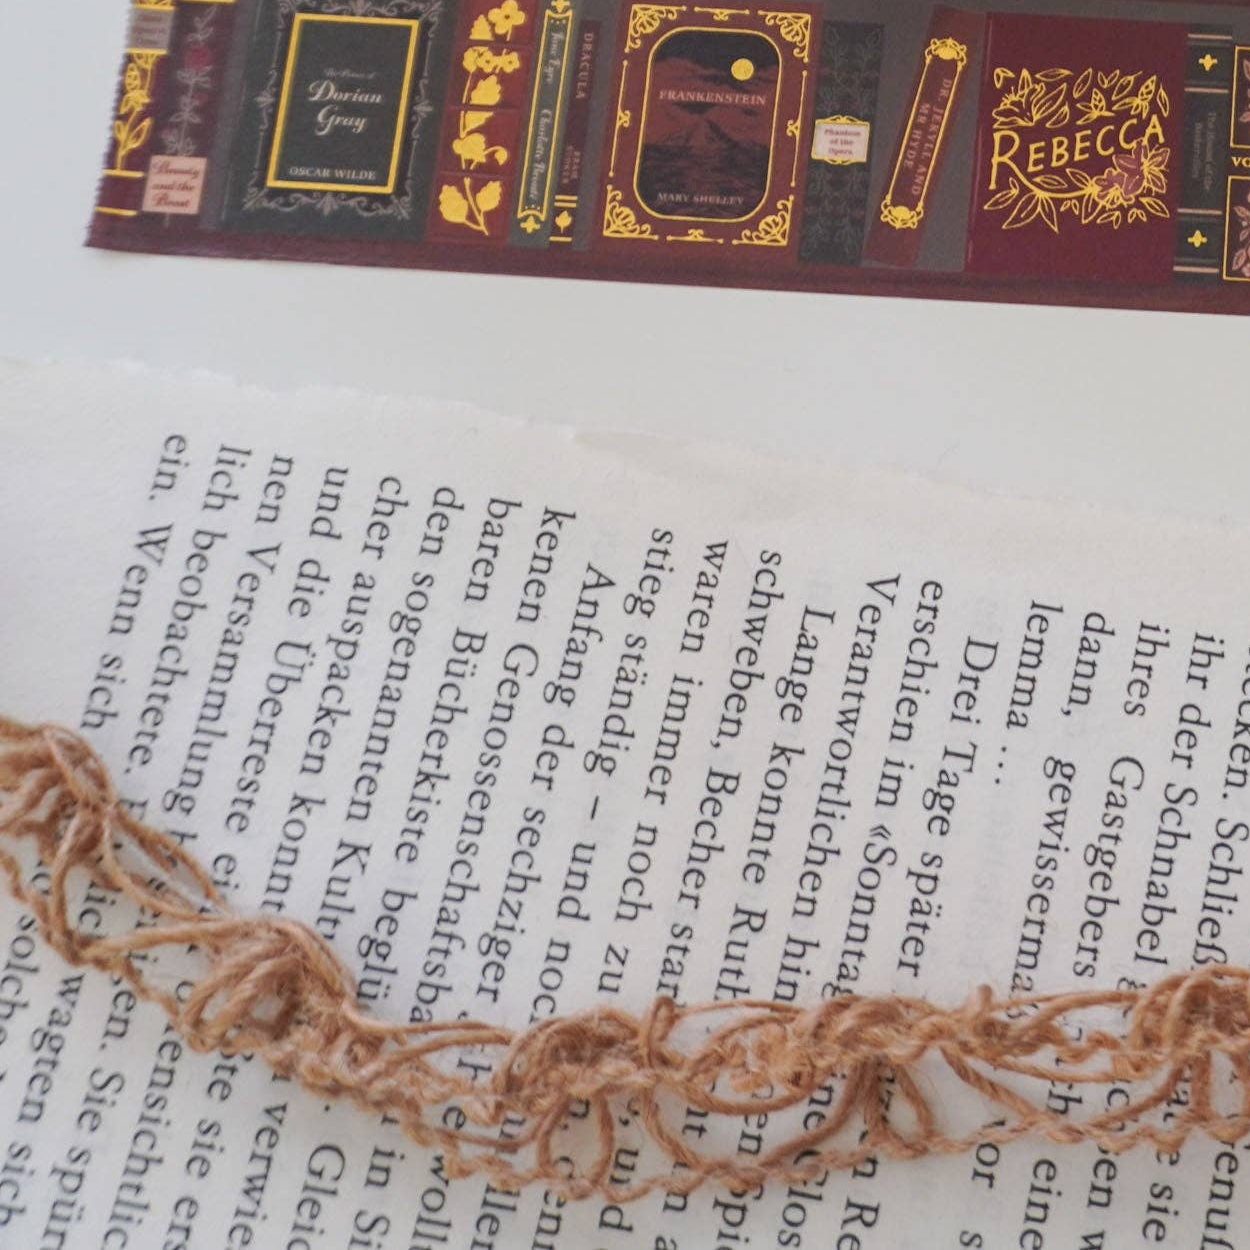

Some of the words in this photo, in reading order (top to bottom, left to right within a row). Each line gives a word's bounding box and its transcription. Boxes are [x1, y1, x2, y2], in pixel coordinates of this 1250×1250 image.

[308, 79, 383, 103] Dorian
[575, 32, 594, 100] DRACULA
[658, 90, 767, 105] FRANKENSTEIN
[314, 104, 368, 136] Gray
[904, 129, 923, 169] HYDE
[988, 113, 1165, 191] REBECCA
[288, 166, 331, 178] OSCAR
[334, 168, 377, 180] WILDE
[656, 192, 689, 203] MARY
[308, 467, 348, 539] und
[287, 558, 330, 617] die
[680, 540, 728, 652] waren
[543, 562, 616, 707] Anfang
[710, 550, 784, 748] schweben,
[1123, 621, 1169, 716] ihres
[1186, 632, 1224, 689] ihr
[950, 635, 998, 724] Drei
[225, 640, 316, 832] Überreste
[531, 724, 574, 790] der
[644, 673, 703, 805] immer
[792, 573, 900, 916] Verantwortlichen
[1171, 703, 1211, 769] der
[922, 741, 977, 836] Tage
[614, 822, 657, 920] noch
[678, 766, 740, 909] Becher
[1072, 756, 1144, 977] Gastgebers
[1134, 782, 1198, 964] Schnabel
[476, 807, 545, 1002] sechziger
[897, 852, 942, 977] später
[597, 943, 628, 992] zu
